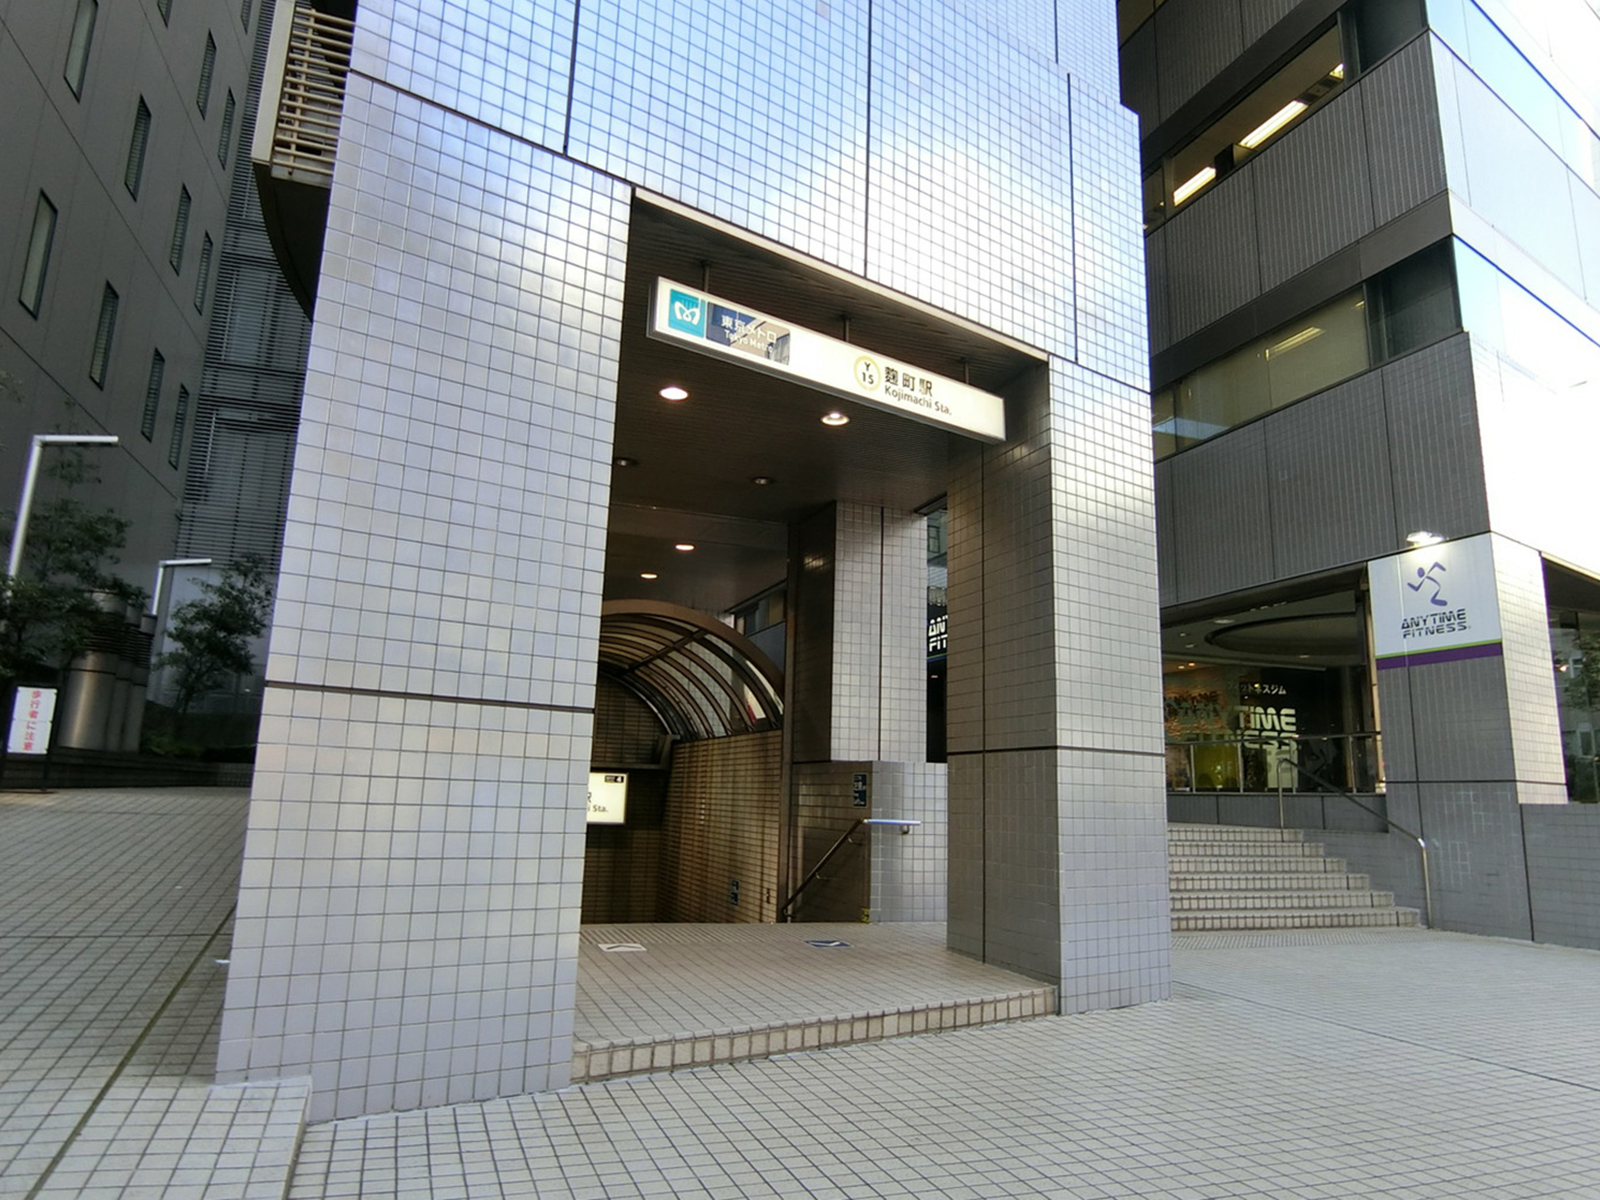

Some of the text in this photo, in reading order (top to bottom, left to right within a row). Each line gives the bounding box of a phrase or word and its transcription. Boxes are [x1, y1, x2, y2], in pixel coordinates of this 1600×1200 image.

[721, 314, 777, 343] 東京メトロ
[724, 329, 775, 355] Tokyo Metro
[864, 361, 871, 371] Y
[862, 371, 874, 385] 15
[884, 385, 952, 415] Kojimachi Sta.
[1401, 608, 1466, 630] ANYTIME
[1403, 620, 1467, 639] FITNESS
[23, 690, 41, 751] 歩行者に注意
[593, 804, 609, 813] Sta.
